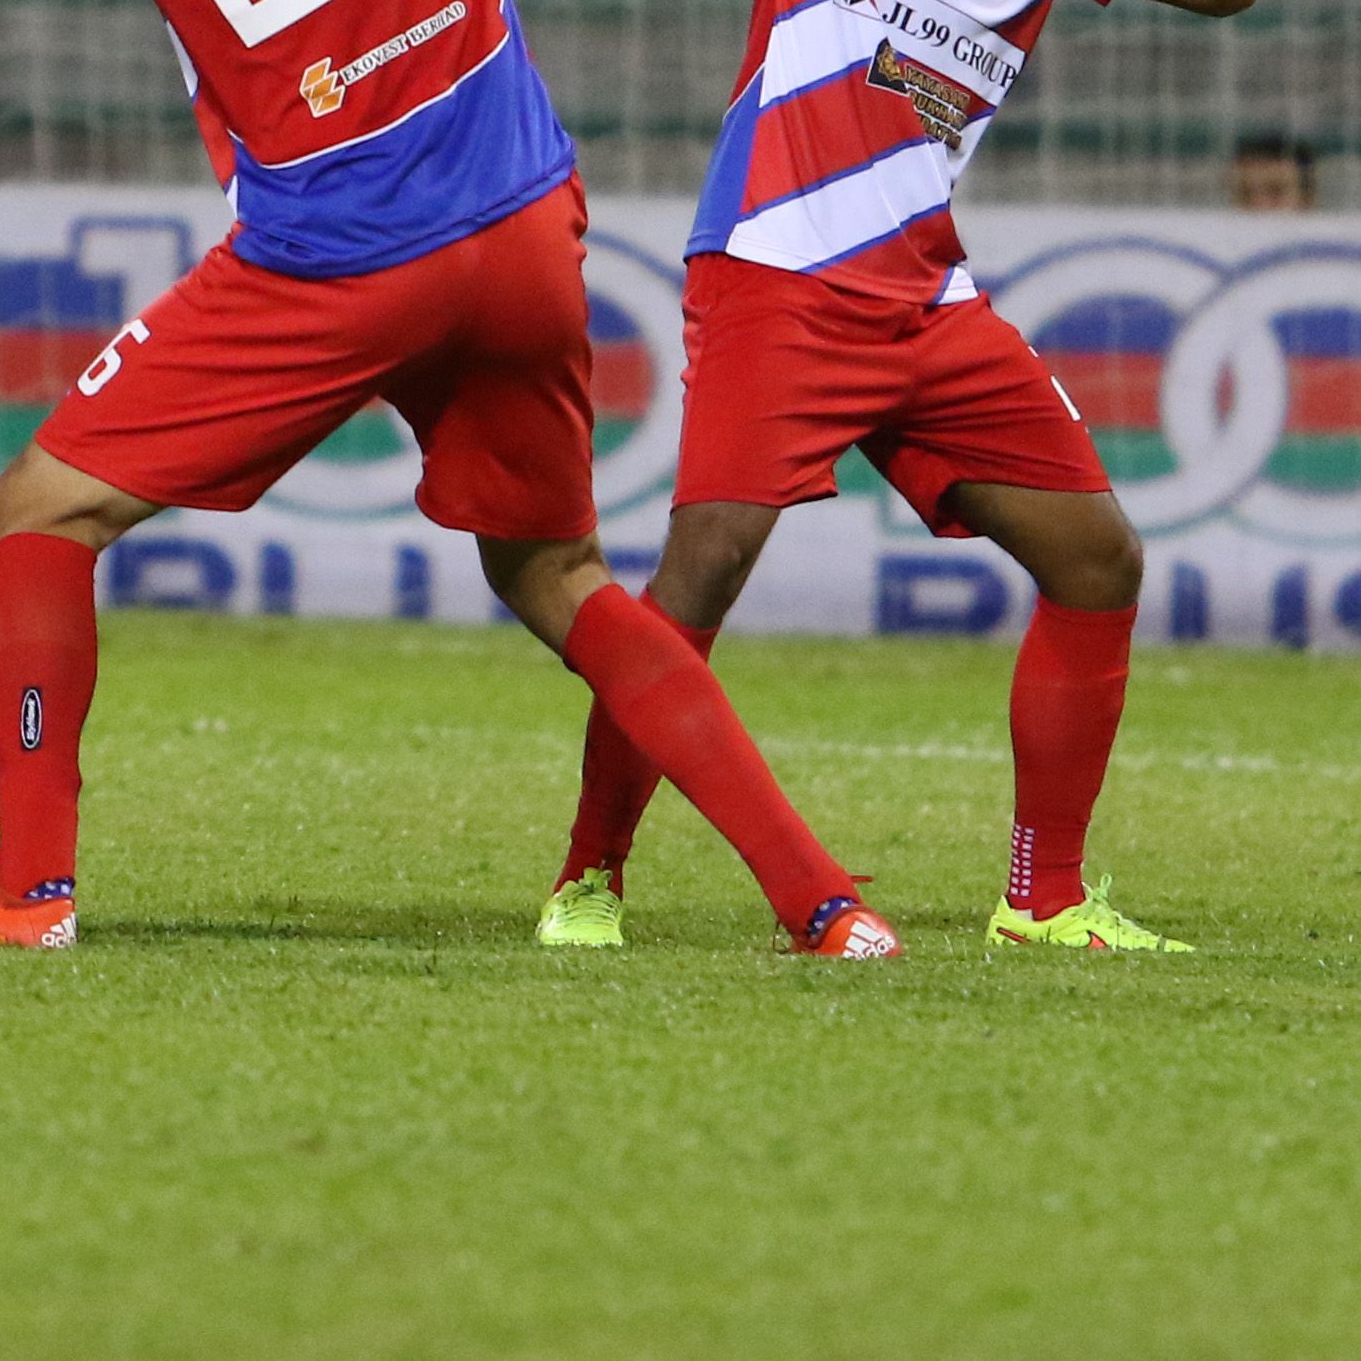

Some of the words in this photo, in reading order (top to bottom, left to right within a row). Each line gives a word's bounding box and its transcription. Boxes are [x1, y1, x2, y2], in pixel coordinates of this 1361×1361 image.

[343, 37, 408, 83] EKOVEST
[881, 1, 951, 48] JL99
[952, 35, 1017, 88] GROUP
